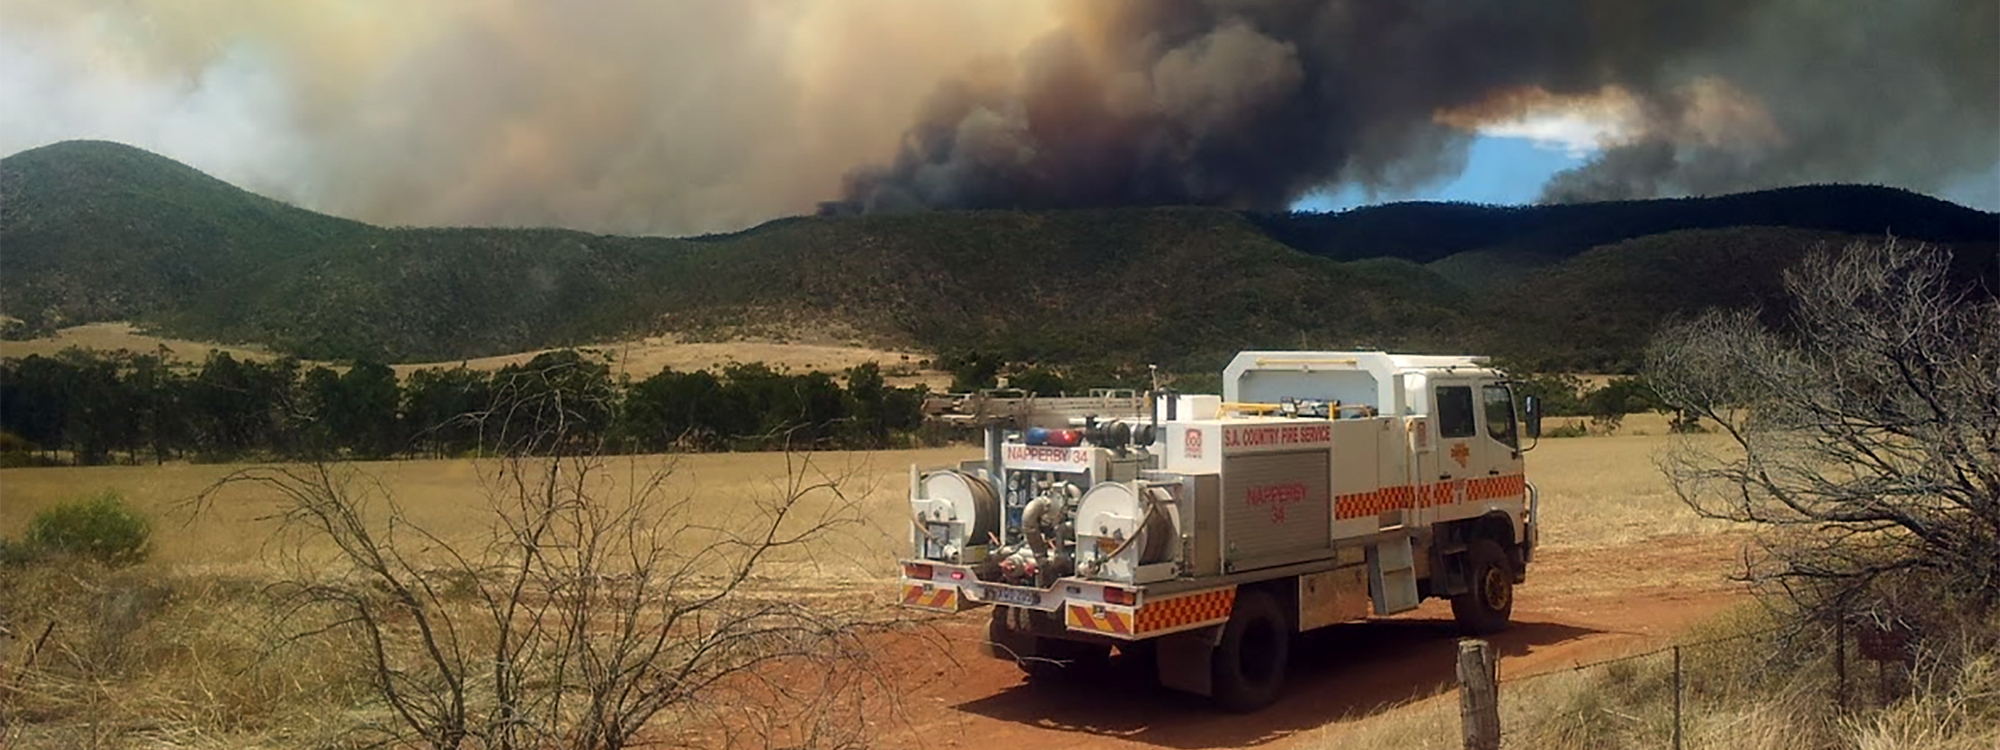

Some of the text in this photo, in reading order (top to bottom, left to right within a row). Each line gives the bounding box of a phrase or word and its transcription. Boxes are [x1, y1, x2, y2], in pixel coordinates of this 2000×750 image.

[1243, 427, 1279, 445] COUNTRY
[1281, 426, 1298, 444] FIRE
[1300, 425, 1331, 442] SERVICE
[1007, 446, 1088, 463] NAPPERBY 34
[1246, 484, 1306, 506] NAPPERBY
[1271, 505, 1285, 525] 34
